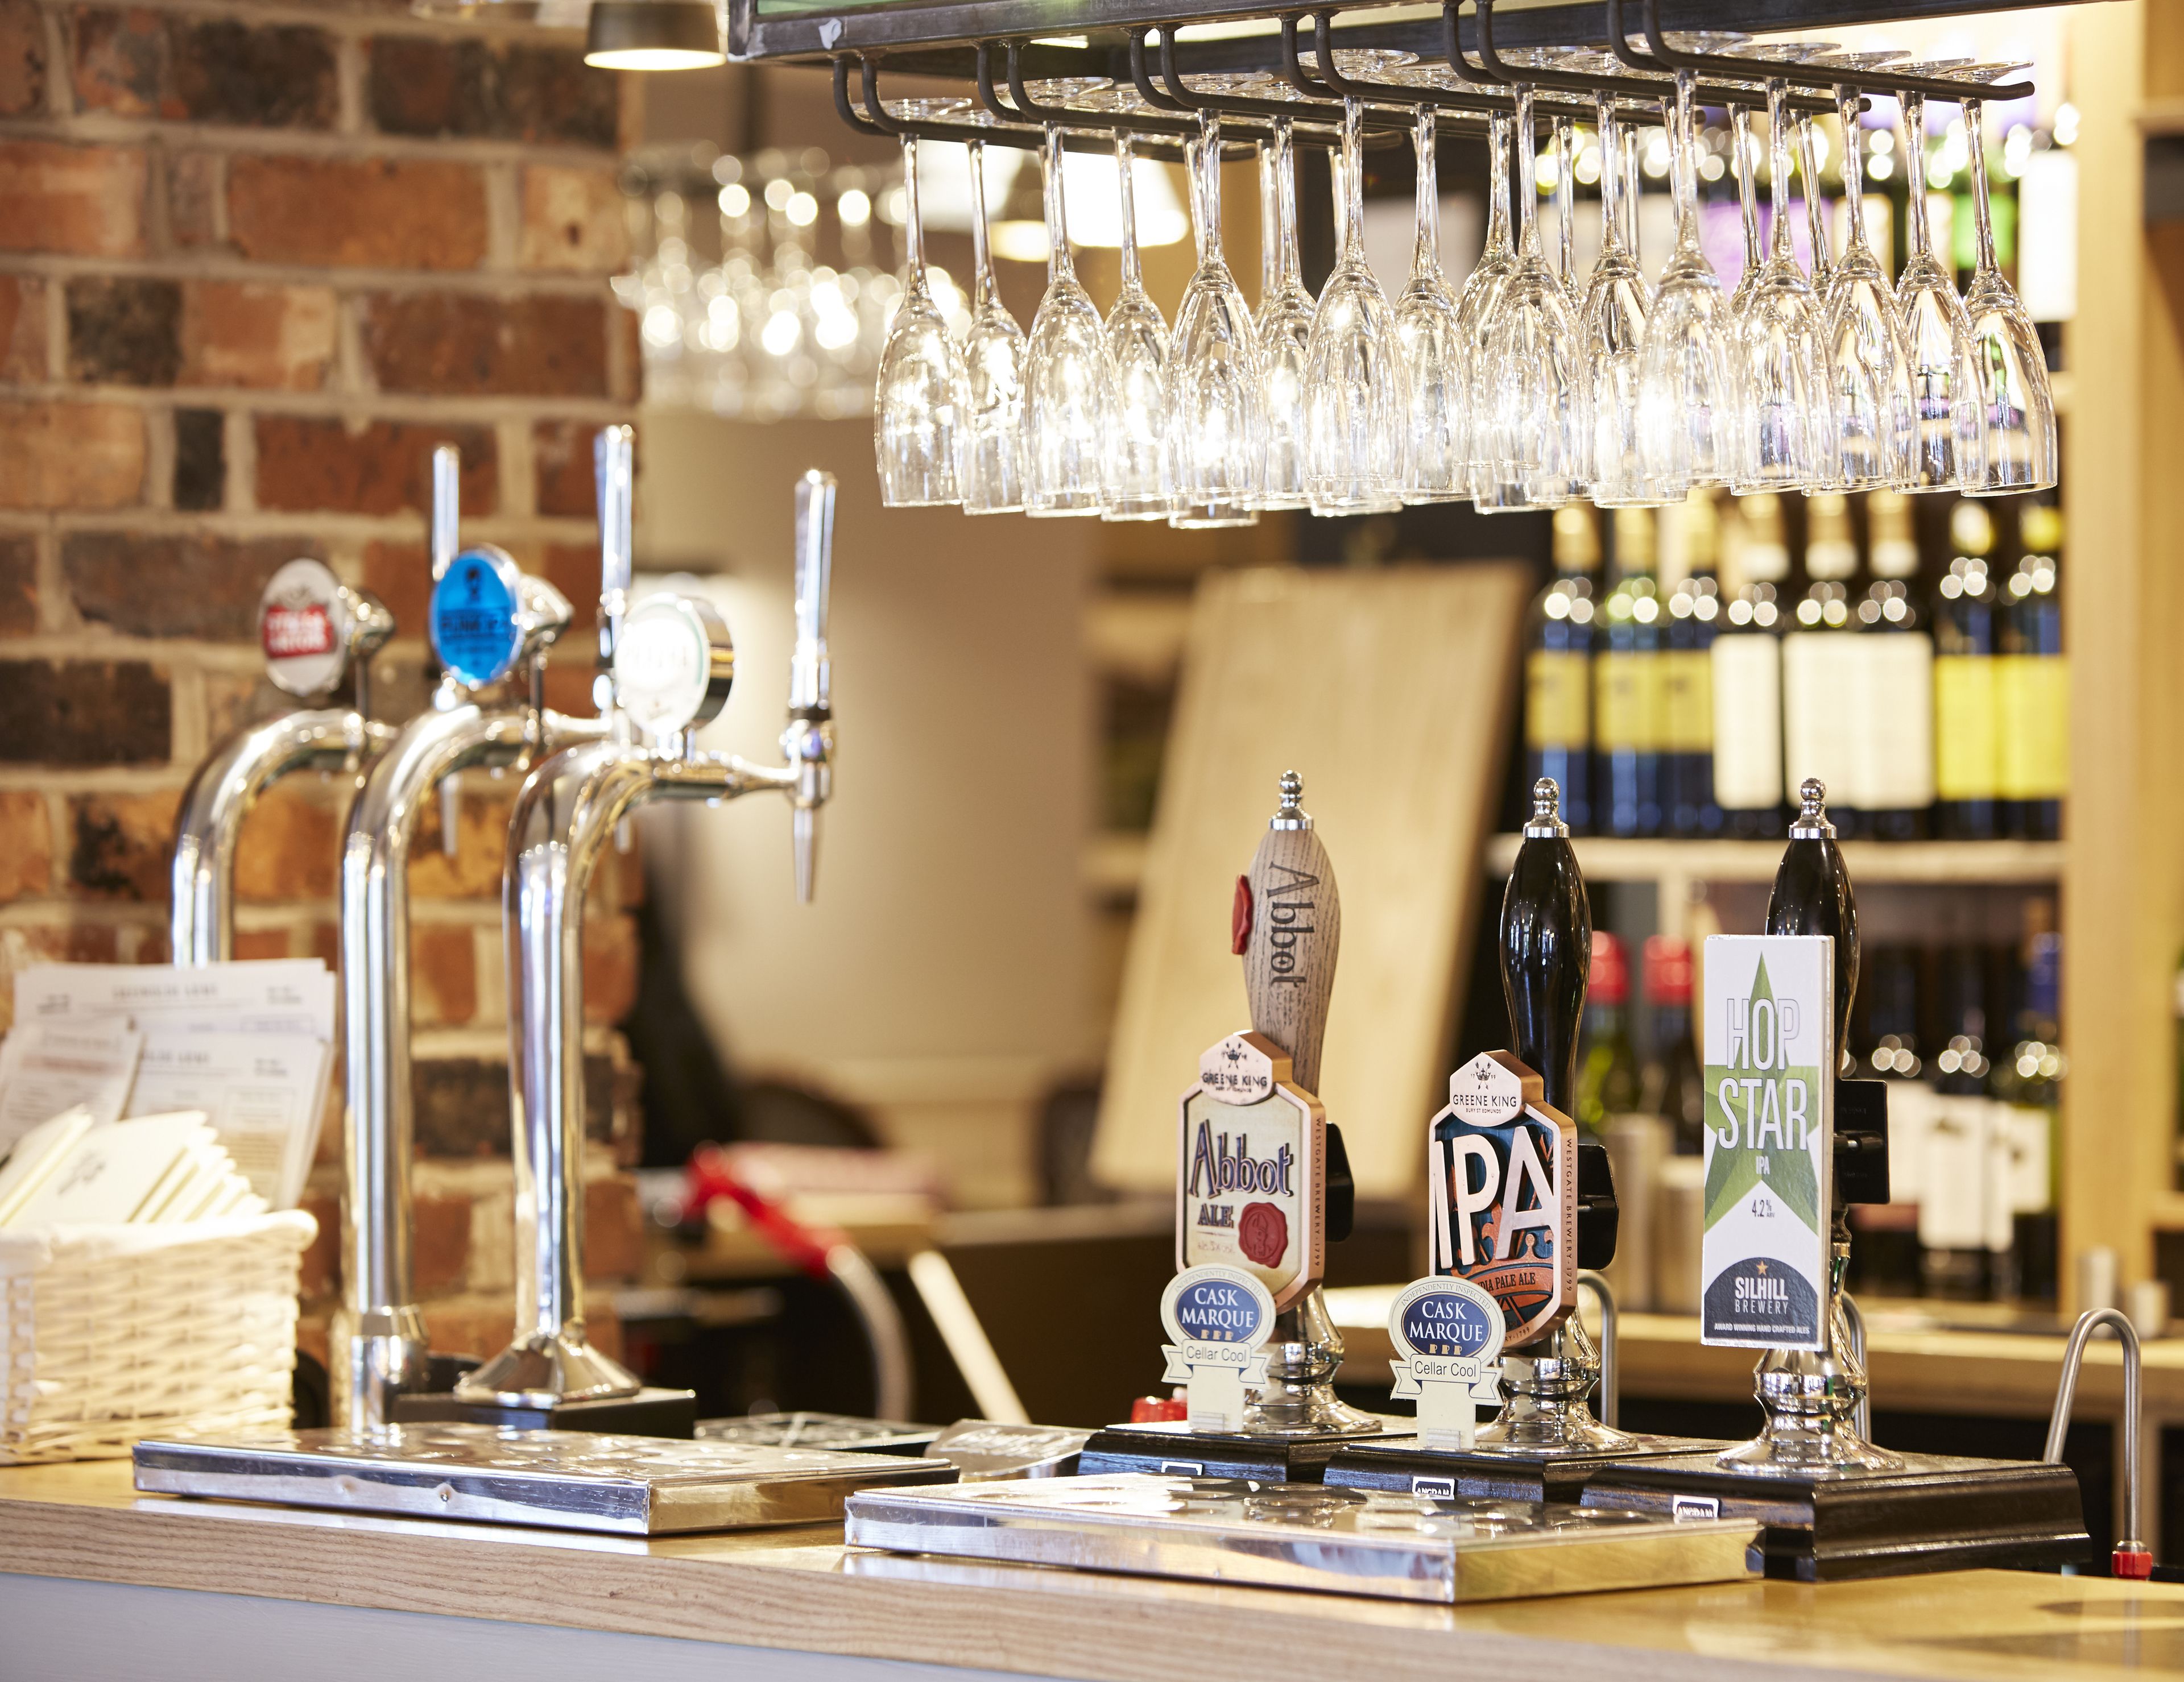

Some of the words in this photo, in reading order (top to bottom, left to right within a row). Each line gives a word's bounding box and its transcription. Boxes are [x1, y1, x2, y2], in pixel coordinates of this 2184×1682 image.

[1267, 861, 1320, 988] Abbot
[1727, 999, 1800, 1070] HOP
[1202, 1072, 1238, 1086] GREENE
[1242, 1075, 1267, 1087] KING
[1453, 1095, 1488, 1106] GREENE
[1492, 1096, 1517, 1107] KING
[1718, 1077, 1807, 1150] STAR
[1189, 1119, 1294, 1199] Abbot
[1756, 1155, 1771, 1175] IPA
[1434, 1126, 1554, 1269] IPA
[1197, 1203, 1234, 1228] ALE
[1176, 1270, 1227, 1293] INDEPENDENTLY
[1228, 1271, 1261, 1297] INSPECTED
[1495, 1274, 1516, 1290] PALE
[1519, 1273, 1536, 1286] ALE
[1735, 1277, 1789, 1300] SILHILL
[1194, 1287, 1238, 1306] CASK
[1402, 1283, 1454, 1306] INDEPENDENTLY
[1455, 1285, 1491, 1310] INSPECTED
[1735, 1299, 1789, 1315] BREWERY
[1181, 1307, 1254, 1329] MARQUE
[1422, 1301, 1467, 1320] CASK
[1409, 1321, 1483, 1343] MARQUE
[1516, 1327, 1529, 1337] 1799
[1714, 1323, 1733, 1331] AWARD
[1734, 1323, 1756, 1332] WINNING
[1756, 1324, 1771, 1333] HAND
[1772, 1325, 1796, 1334] CRAFTED
[1796, 1326, 1810, 1335] ALES
[1186, 1346, 1218, 1360] Cellar
[1221, 1348, 1247, 1362] Cool
[1415, 1361, 1447, 1375] Cellar
[1451, 1363, 1476, 1377] Cool
